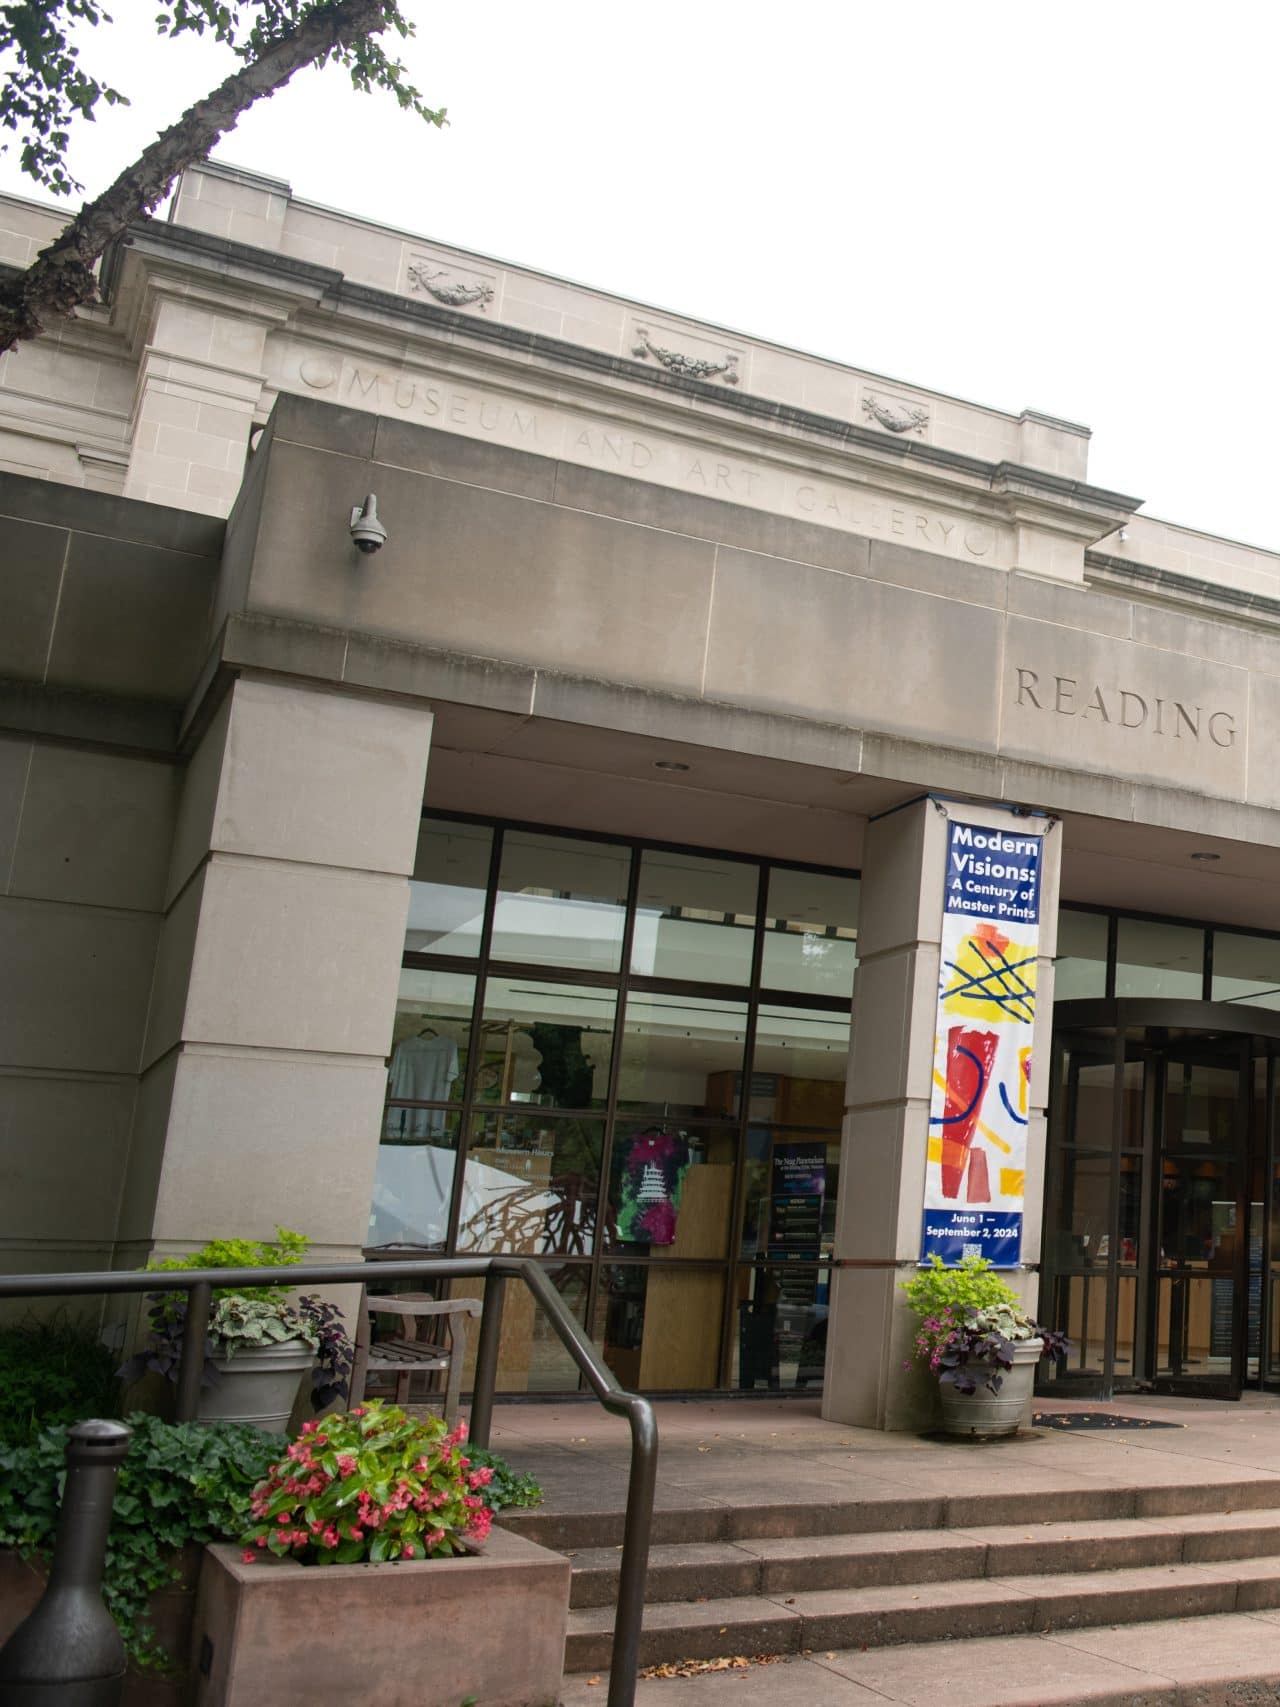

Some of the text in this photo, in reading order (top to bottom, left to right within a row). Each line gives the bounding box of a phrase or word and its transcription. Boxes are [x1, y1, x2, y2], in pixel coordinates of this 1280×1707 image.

[349, 368, 955, 543] MUSEUM AND ART GALLERY
[1015, 667, 1238, 748] READING
[952, 825, 1038, 857] Modern
[951, 852, 1036, 883] Visions:
[951, 878, 1035, 902] A Century of
[948, 896, 1036, 919] Master Prints
[951, 1213, 976, 1223] June
[979, 1214, 984, 1222] 1
[926, 1226, 1019, 1239] September 2, 2024
